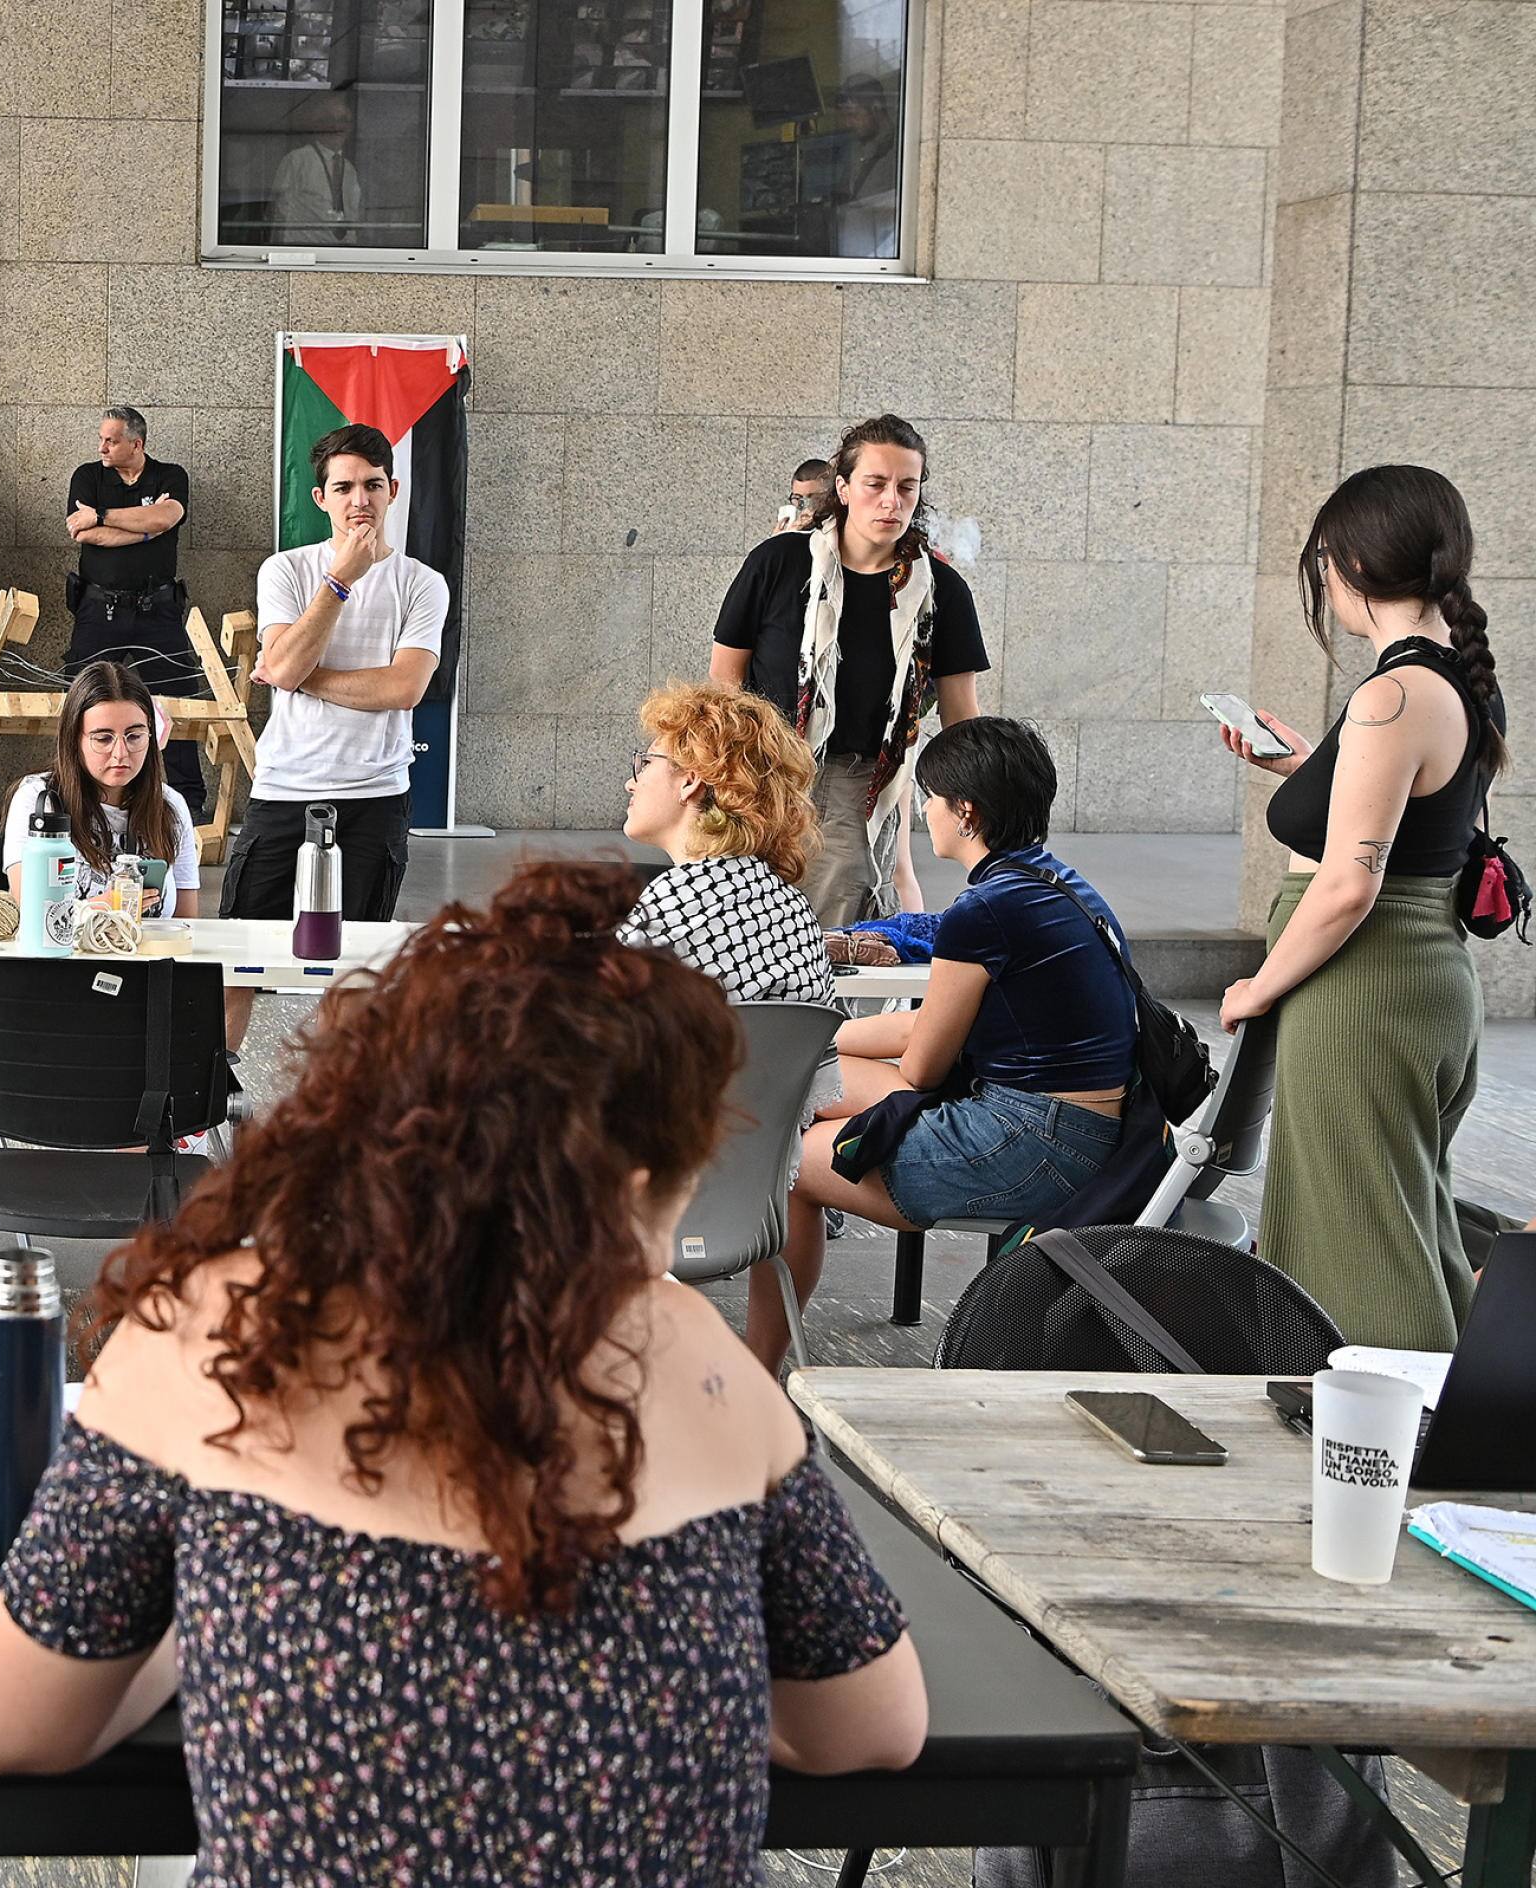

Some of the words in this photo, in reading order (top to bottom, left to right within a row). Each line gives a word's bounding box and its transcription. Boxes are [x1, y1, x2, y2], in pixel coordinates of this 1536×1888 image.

[1325, 1449, 1335, 1460] IL
[1326, 1439, 1389, 1458] RISPETTA
[1325, 1459, 1341, 1471] UN
[1345, 1465, 1393, 1479] SORSO
[1325, 1469, 1358, 1485] ALLA
[1361, 1477, 1400, 1488] VOLTA
